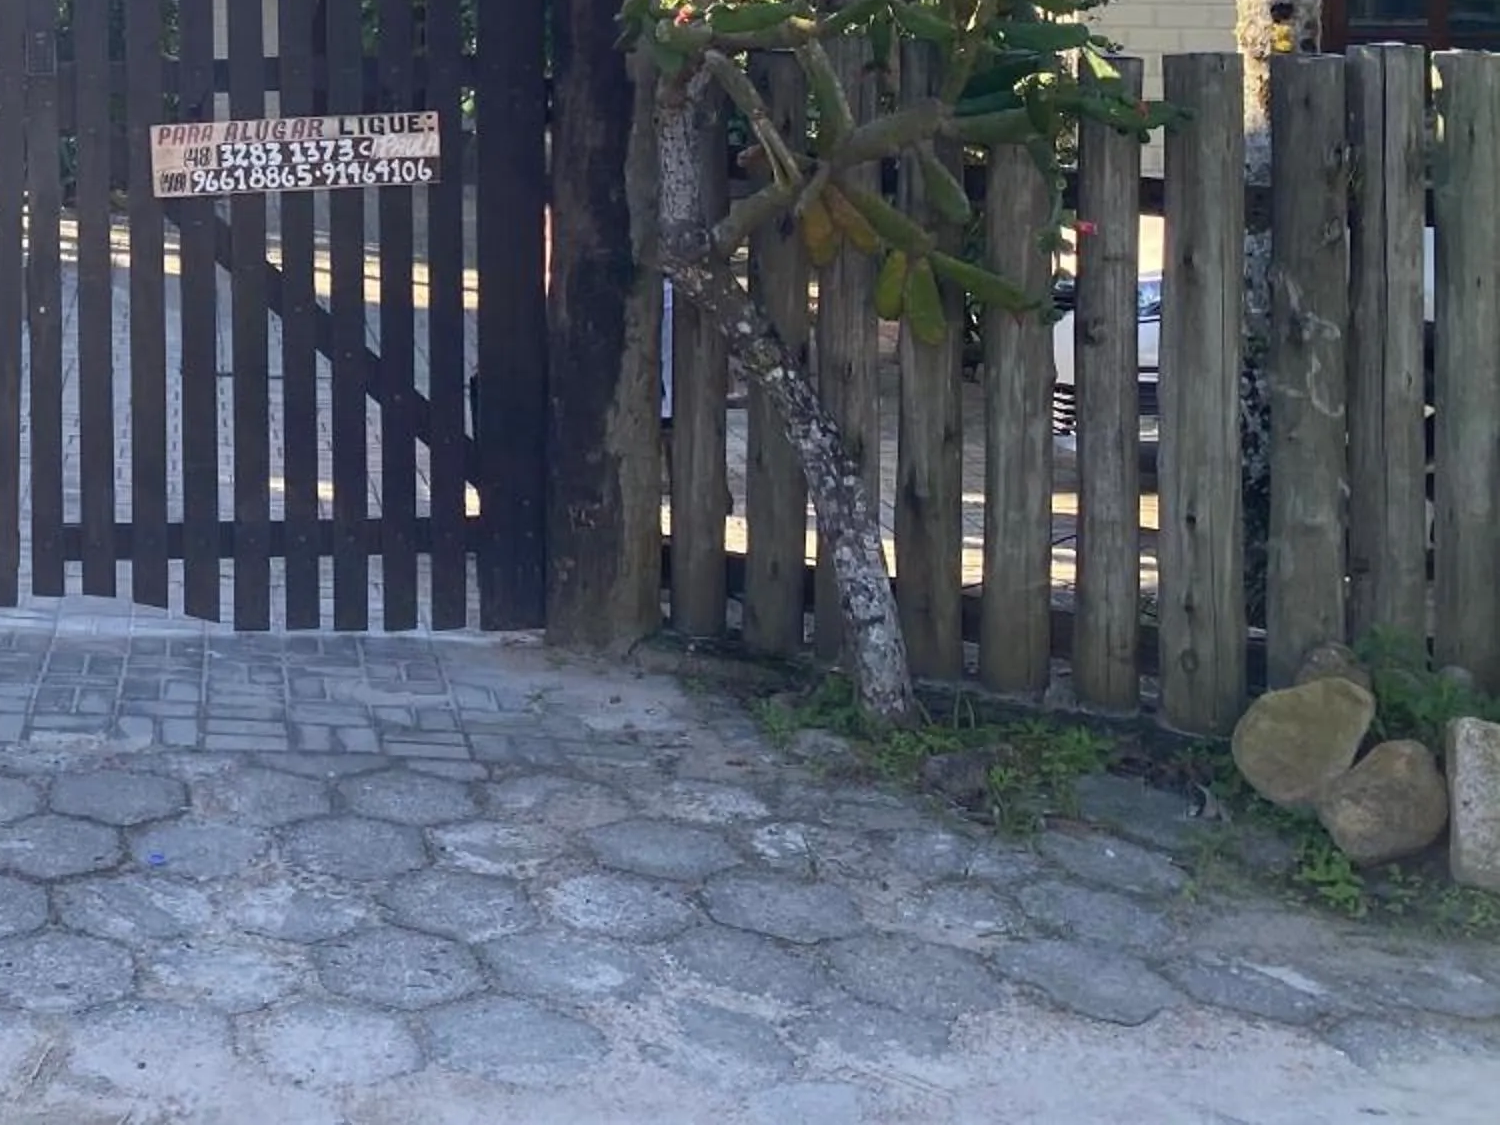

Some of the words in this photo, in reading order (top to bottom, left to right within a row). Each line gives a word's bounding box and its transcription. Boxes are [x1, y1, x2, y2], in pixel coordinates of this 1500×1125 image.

[158, 125, 213, 146] PARA
[224, 118, 324, 143] ALUGAR
[338, 114, 435, 136] LIGUE:
[220, 141, 283, 168] 3283
[288, 138, 354, 163] 1373
